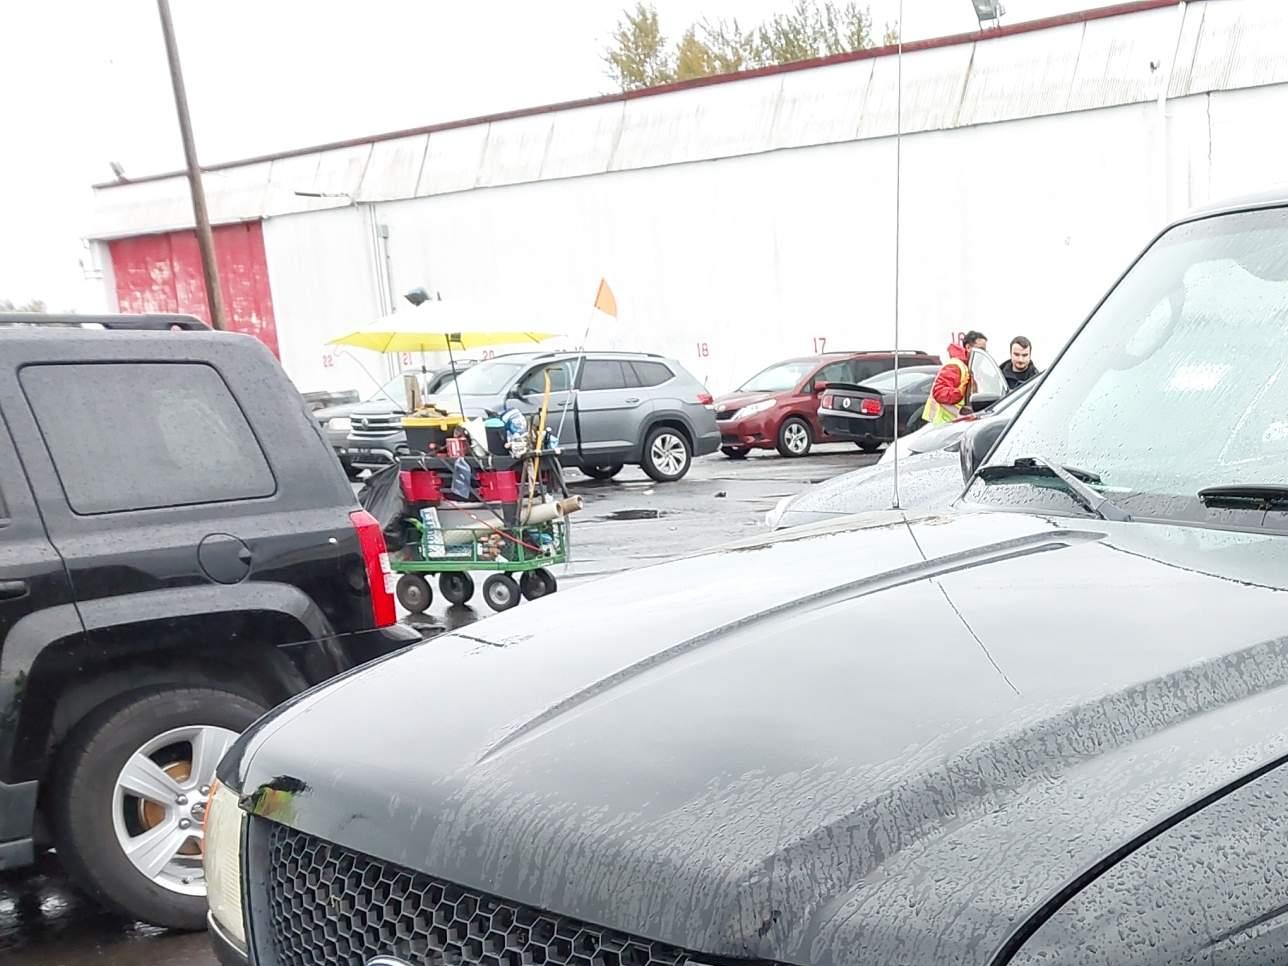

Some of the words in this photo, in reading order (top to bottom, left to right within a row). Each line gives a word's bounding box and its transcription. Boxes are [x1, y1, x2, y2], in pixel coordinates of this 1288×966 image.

[697, 342, 709, 357] 18
[813, 337, 827, 354] 17
[322, 354, 334, 368] 22
[402, 351, 413, 365] 21
